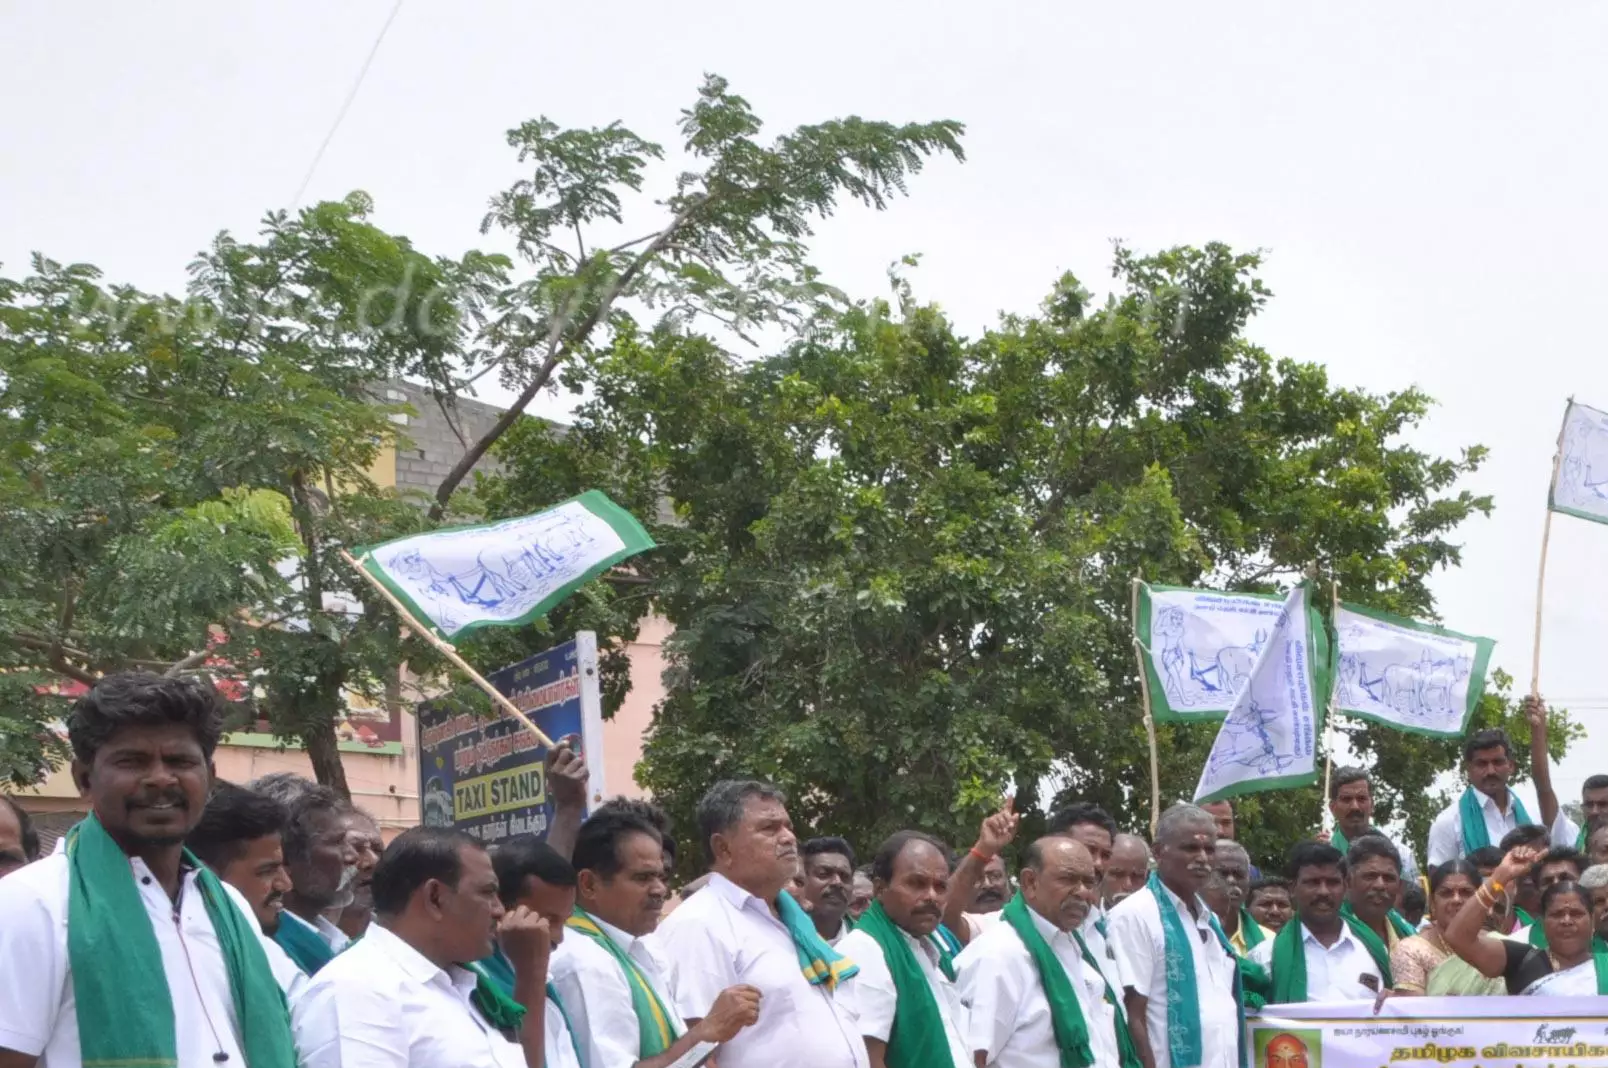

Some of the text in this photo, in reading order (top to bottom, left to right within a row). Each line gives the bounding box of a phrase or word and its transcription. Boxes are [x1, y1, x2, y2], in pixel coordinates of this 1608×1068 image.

[456, 769, 542, 814] TAXI STAND
[1390, 1042, 1477, 1064] தமிழக
